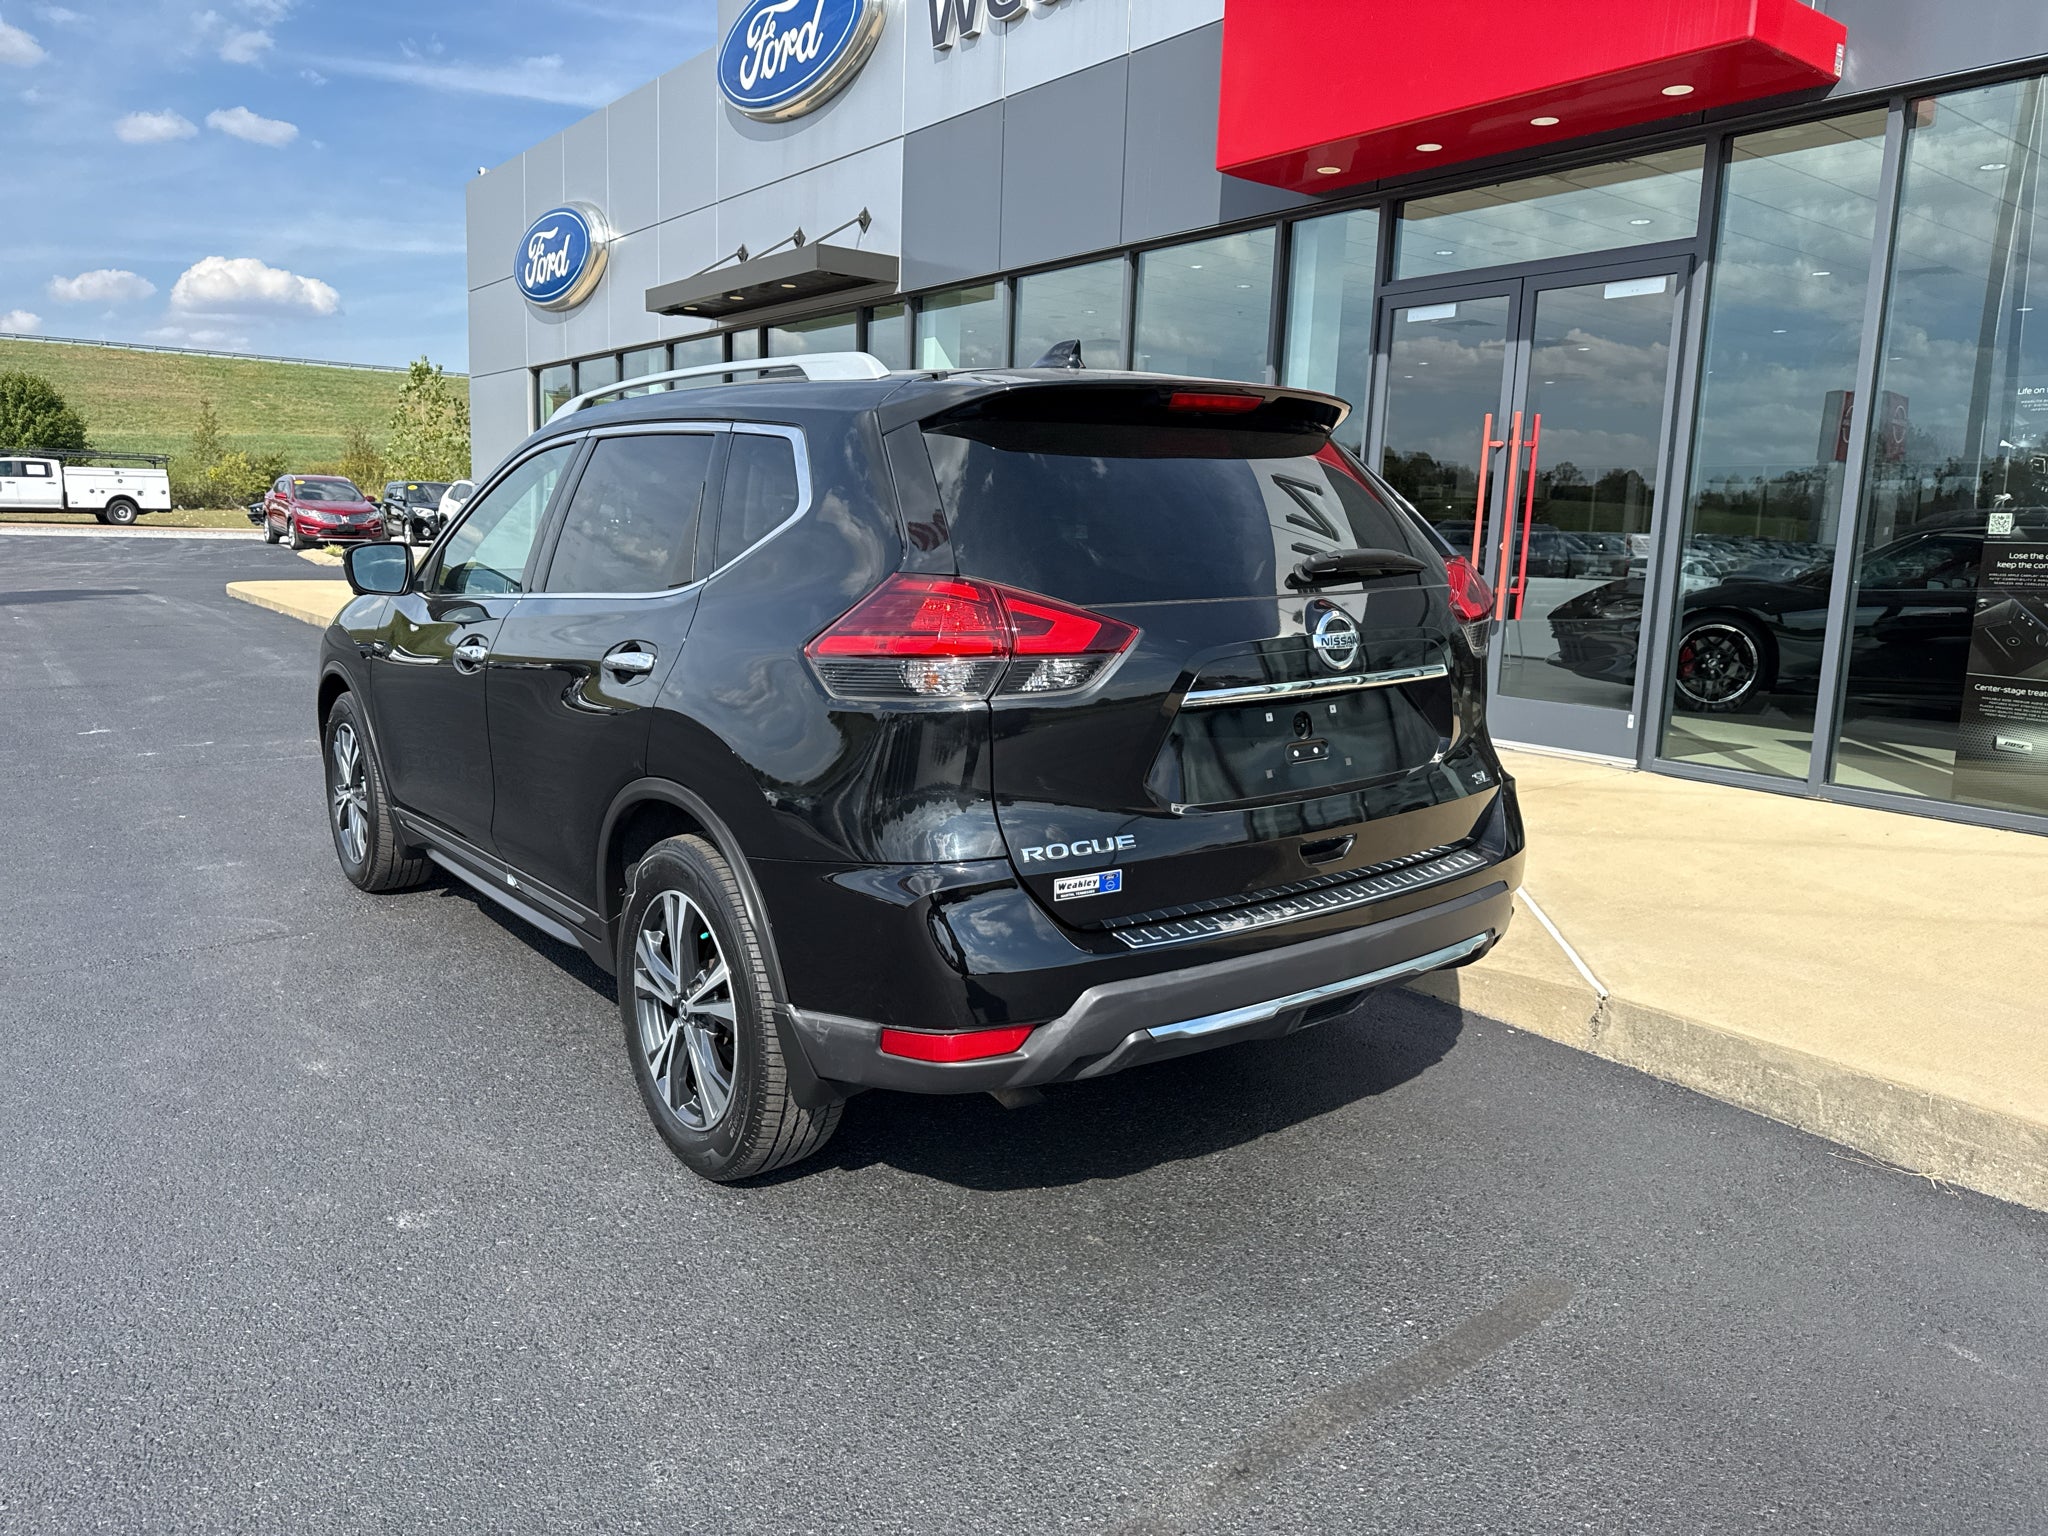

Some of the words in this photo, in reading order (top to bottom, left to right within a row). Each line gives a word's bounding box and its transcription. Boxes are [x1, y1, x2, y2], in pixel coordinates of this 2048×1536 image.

[739, 0, 824, 91] Ford
[525, 226, 571, 288] Ford
[2009, 552, 2029, 560] Lose
[1997, 561, 2017, 569] keep
[1321, 635, 1358, 646] NISSAN
[1974, 683, 2026, 695] Center-stage
[1020, 834, 1137, 863] ROGUE
[1058, 879, 1098, 891] Weakley
